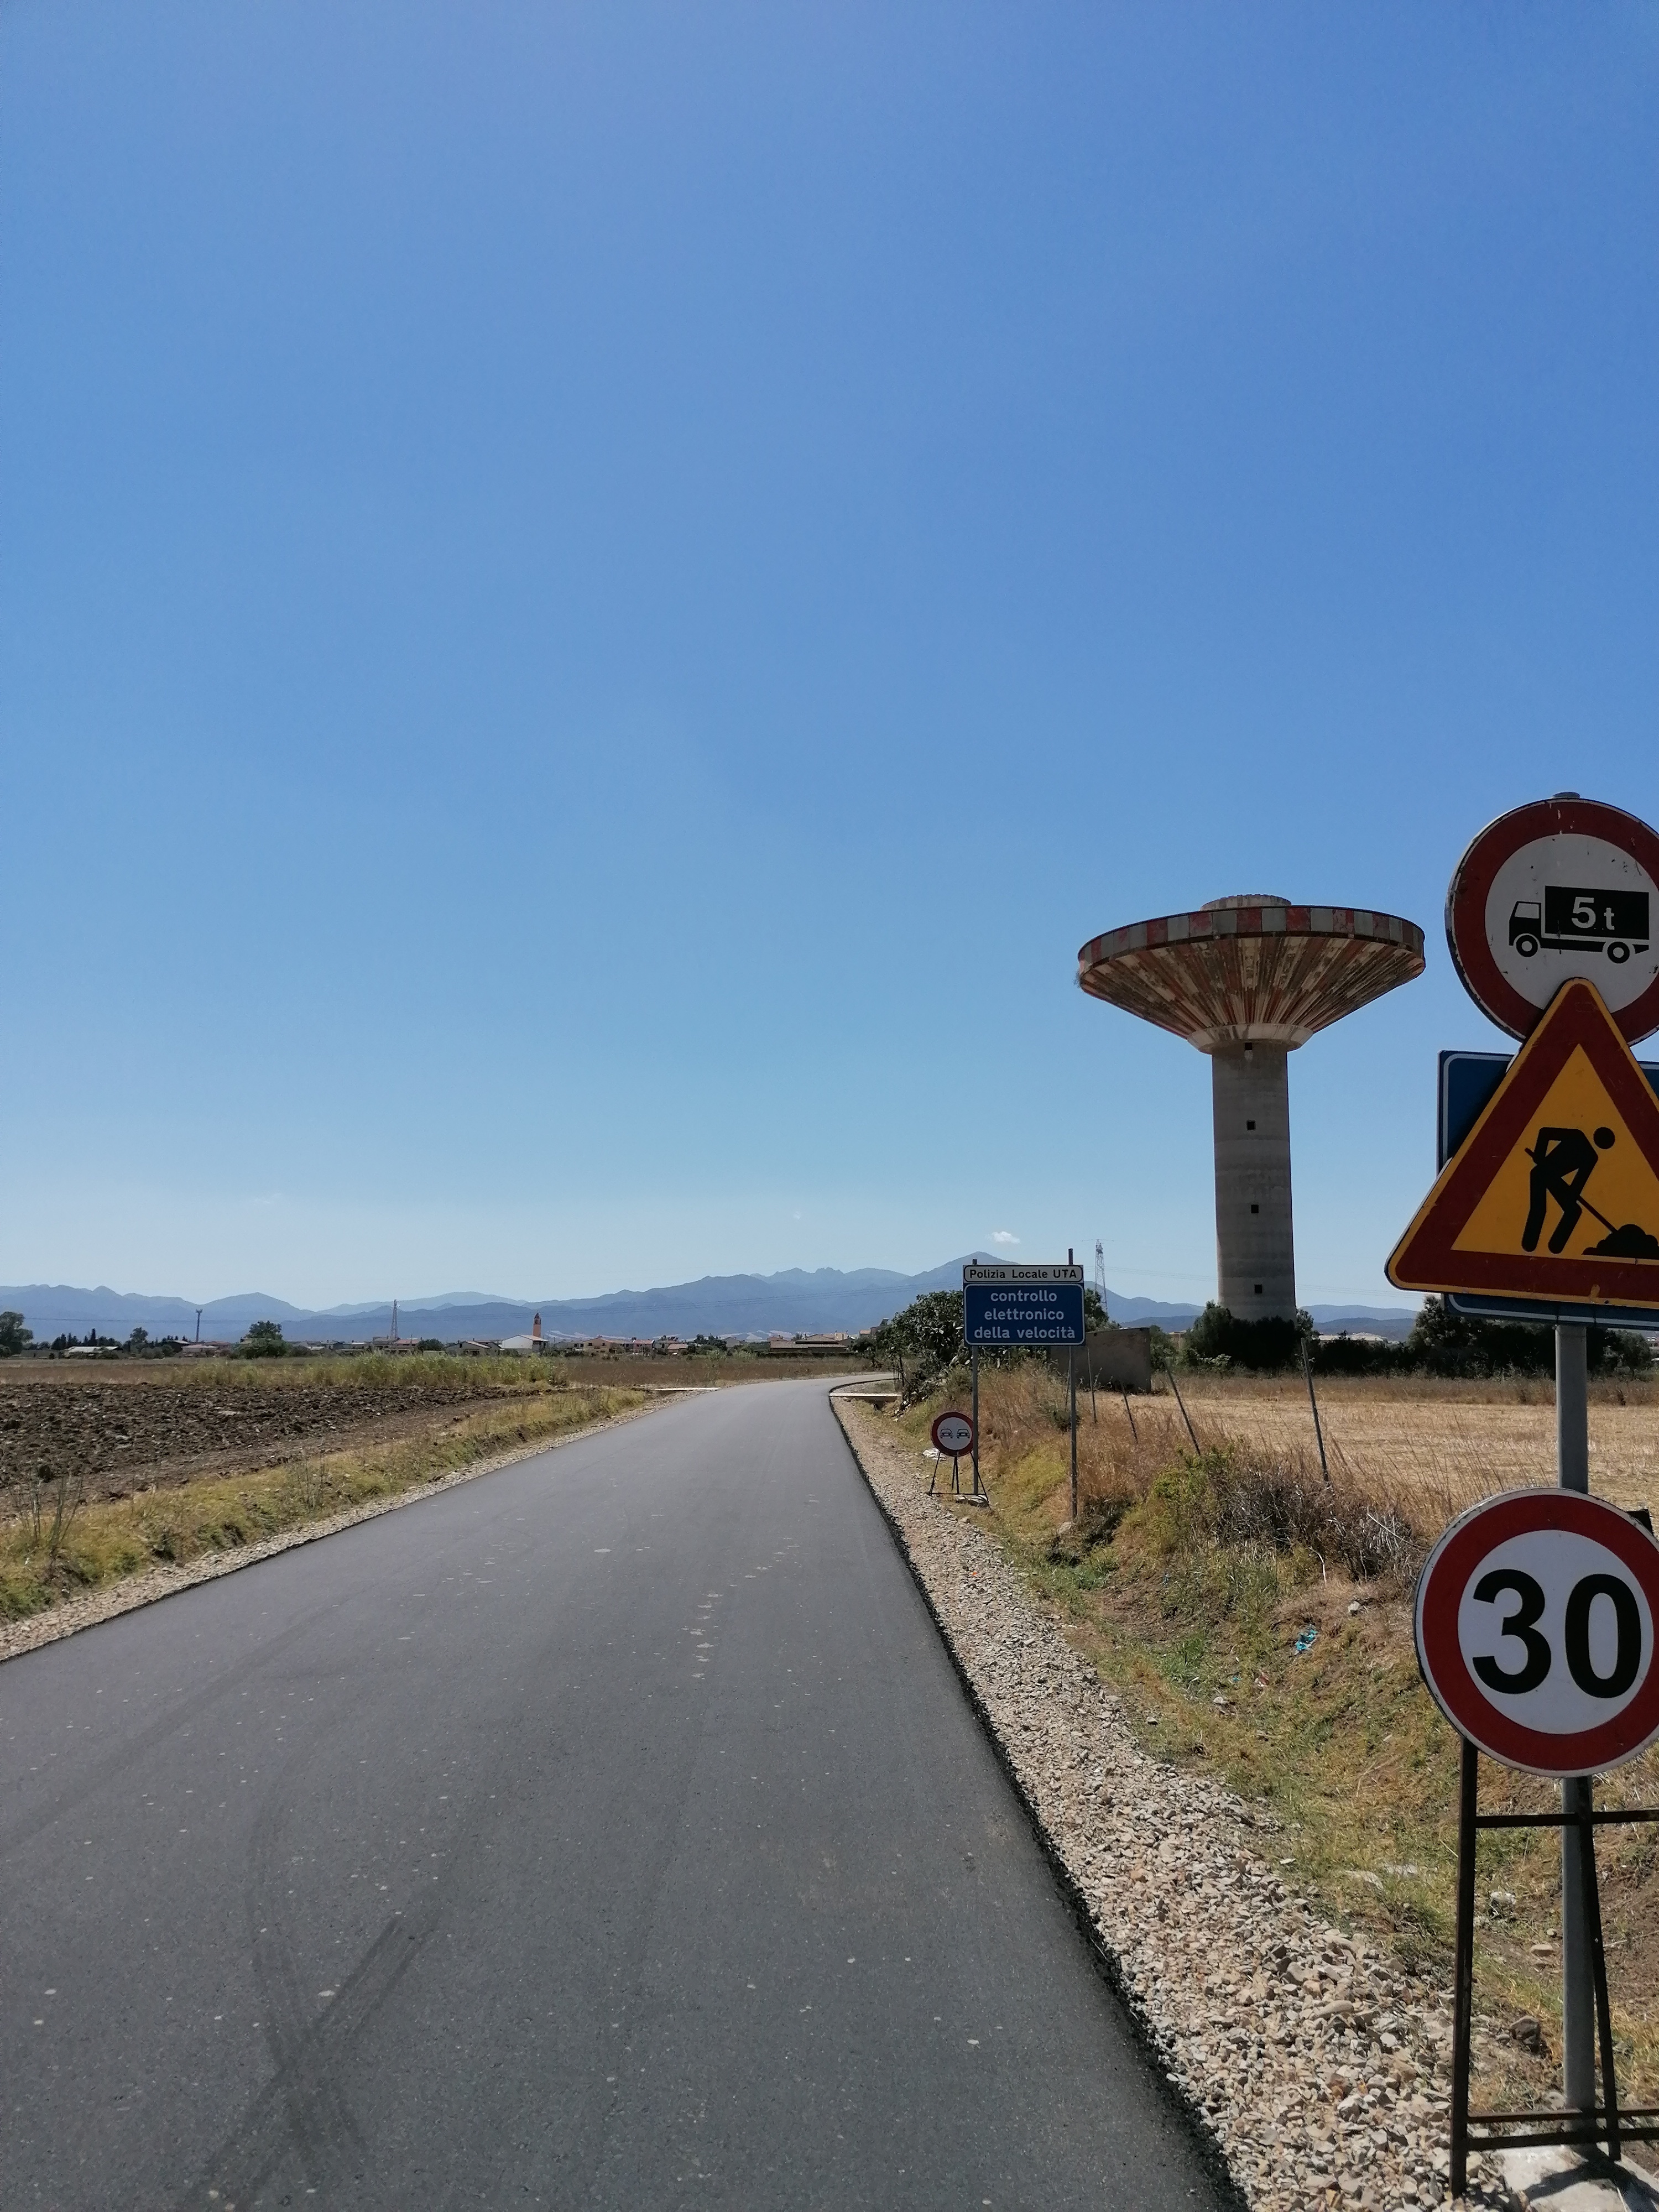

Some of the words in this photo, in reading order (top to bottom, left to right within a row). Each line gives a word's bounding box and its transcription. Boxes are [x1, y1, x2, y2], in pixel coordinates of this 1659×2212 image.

[1571, 896, 1596, 928] 5
[1604, 907, 1615, 930] t
[969, 1269, 1005, 1279] Polizia
[1012, 1269, 1048, 1279] Locale
[1053, 1269, 1077, 1279] UTA
[990, 1290, 1057, 1302] controllo
[984, 1308, 1065, 1320] elettronico
[974, 1326, 1010, 1338] della
[1016, 1326, 1075, 1338] velocità
[1472, 1569, 1641, 1698] 30
